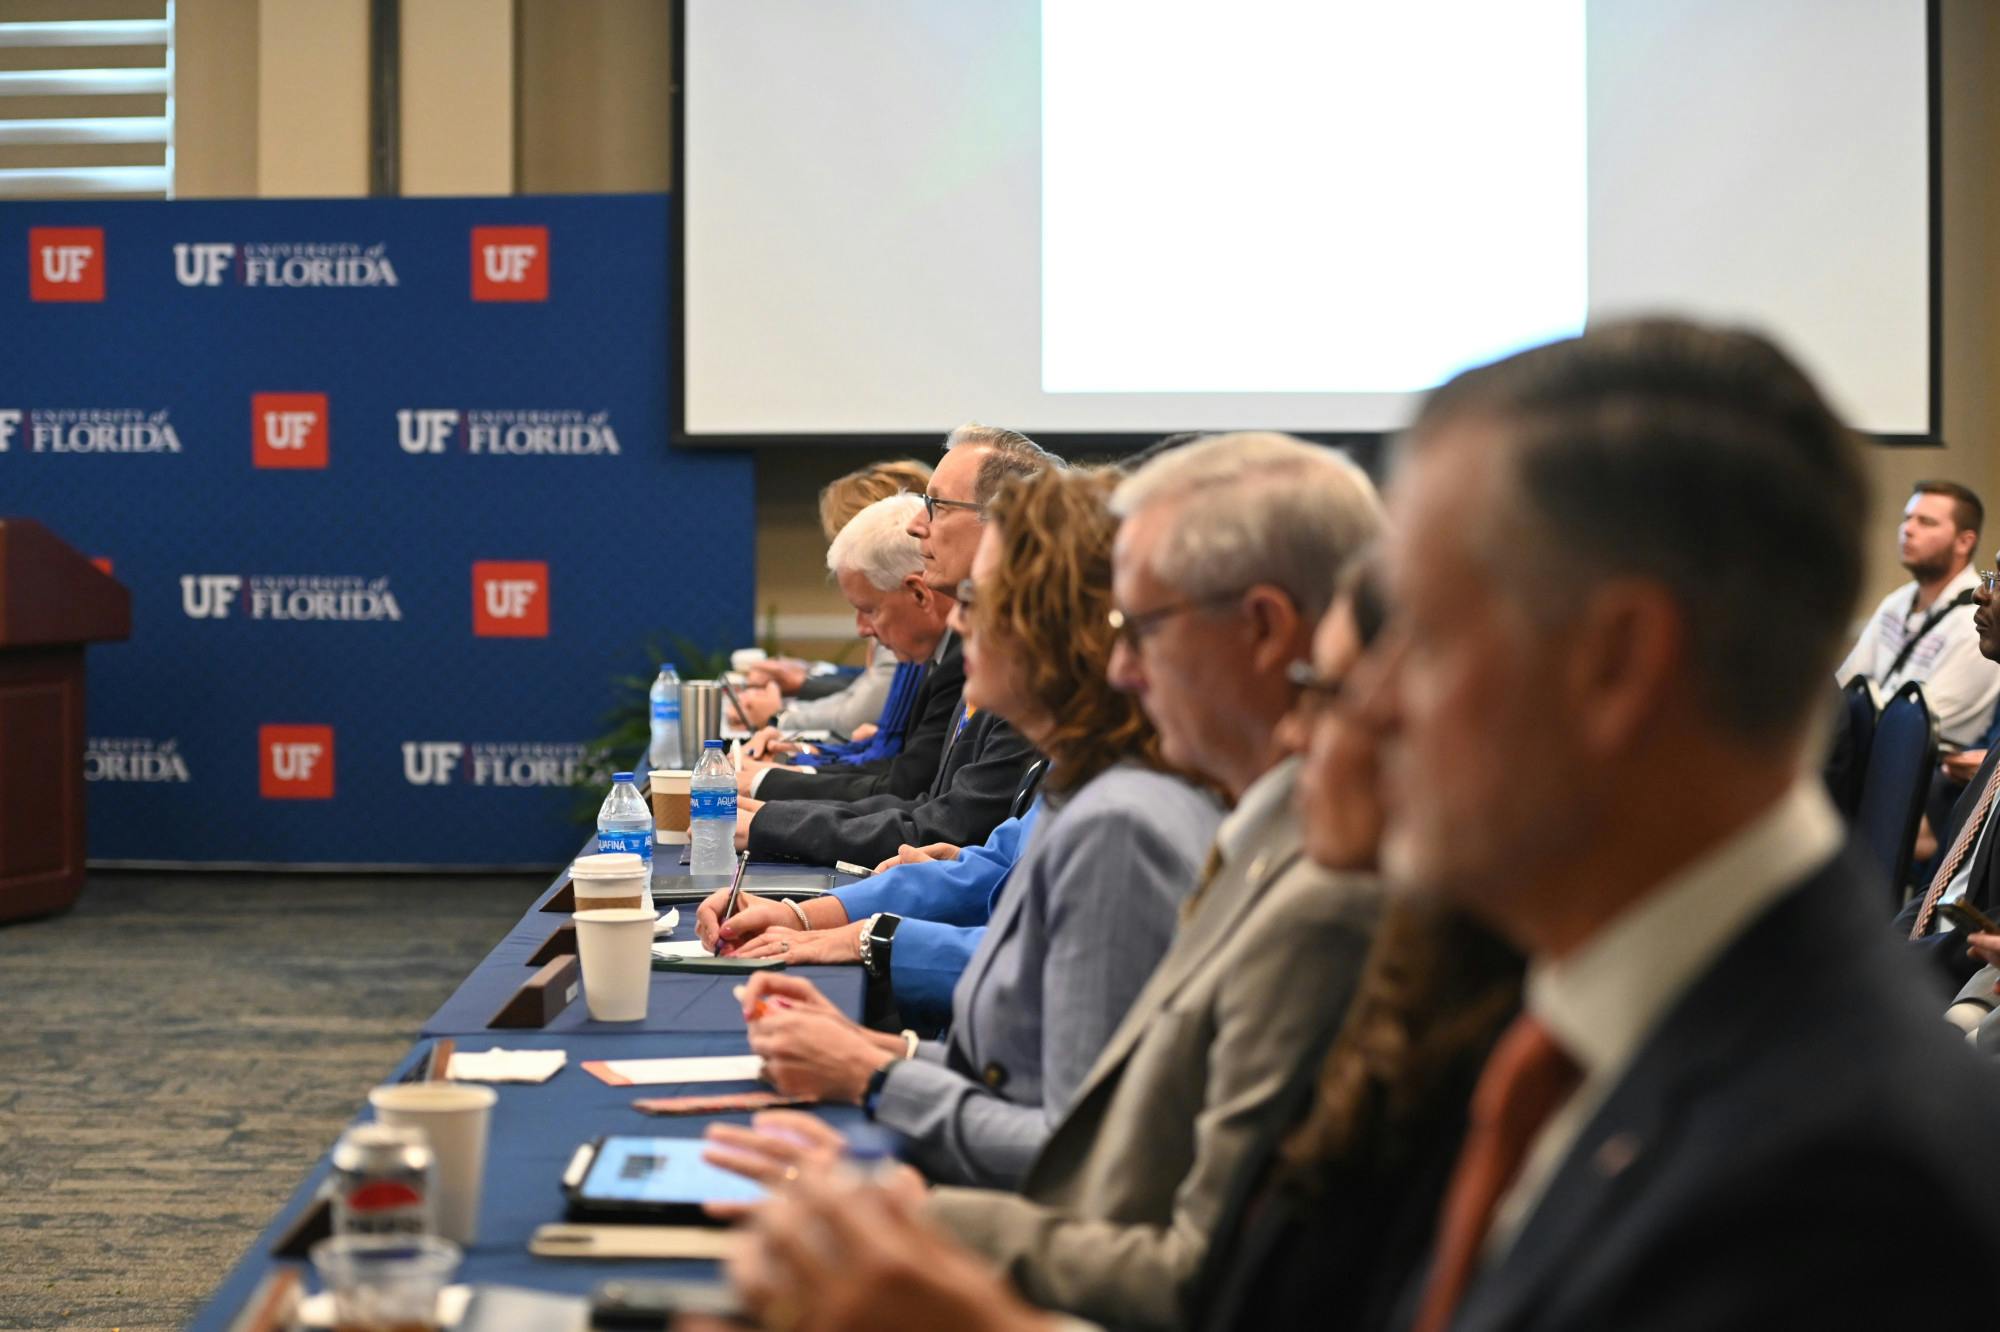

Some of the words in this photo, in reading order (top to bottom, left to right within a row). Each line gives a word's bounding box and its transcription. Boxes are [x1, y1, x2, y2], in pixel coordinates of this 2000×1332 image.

[42, 245, 94, 283] UF
[173, 243, 235, 287] UF
[246, 257, 399, 287] FLORIDA
[483, 245, 538, 283] UF
[0, 408, 22, 451] F
[33, 423, 182, 453] FLORIDA
[264, 411, 317, 450] UF
[396, 409, 458, 454] UF
[468, 424, 621, 455] FLORIDA
[180, 575, 242, 619] UF
[251, 590, 402, 621] FLORIDA
[484, 579, 538, 618] UF
[84, 751, 191, 782] ORIDA
[270, 742, 323, 781] UF
[402, 741, 464, 785] UF
